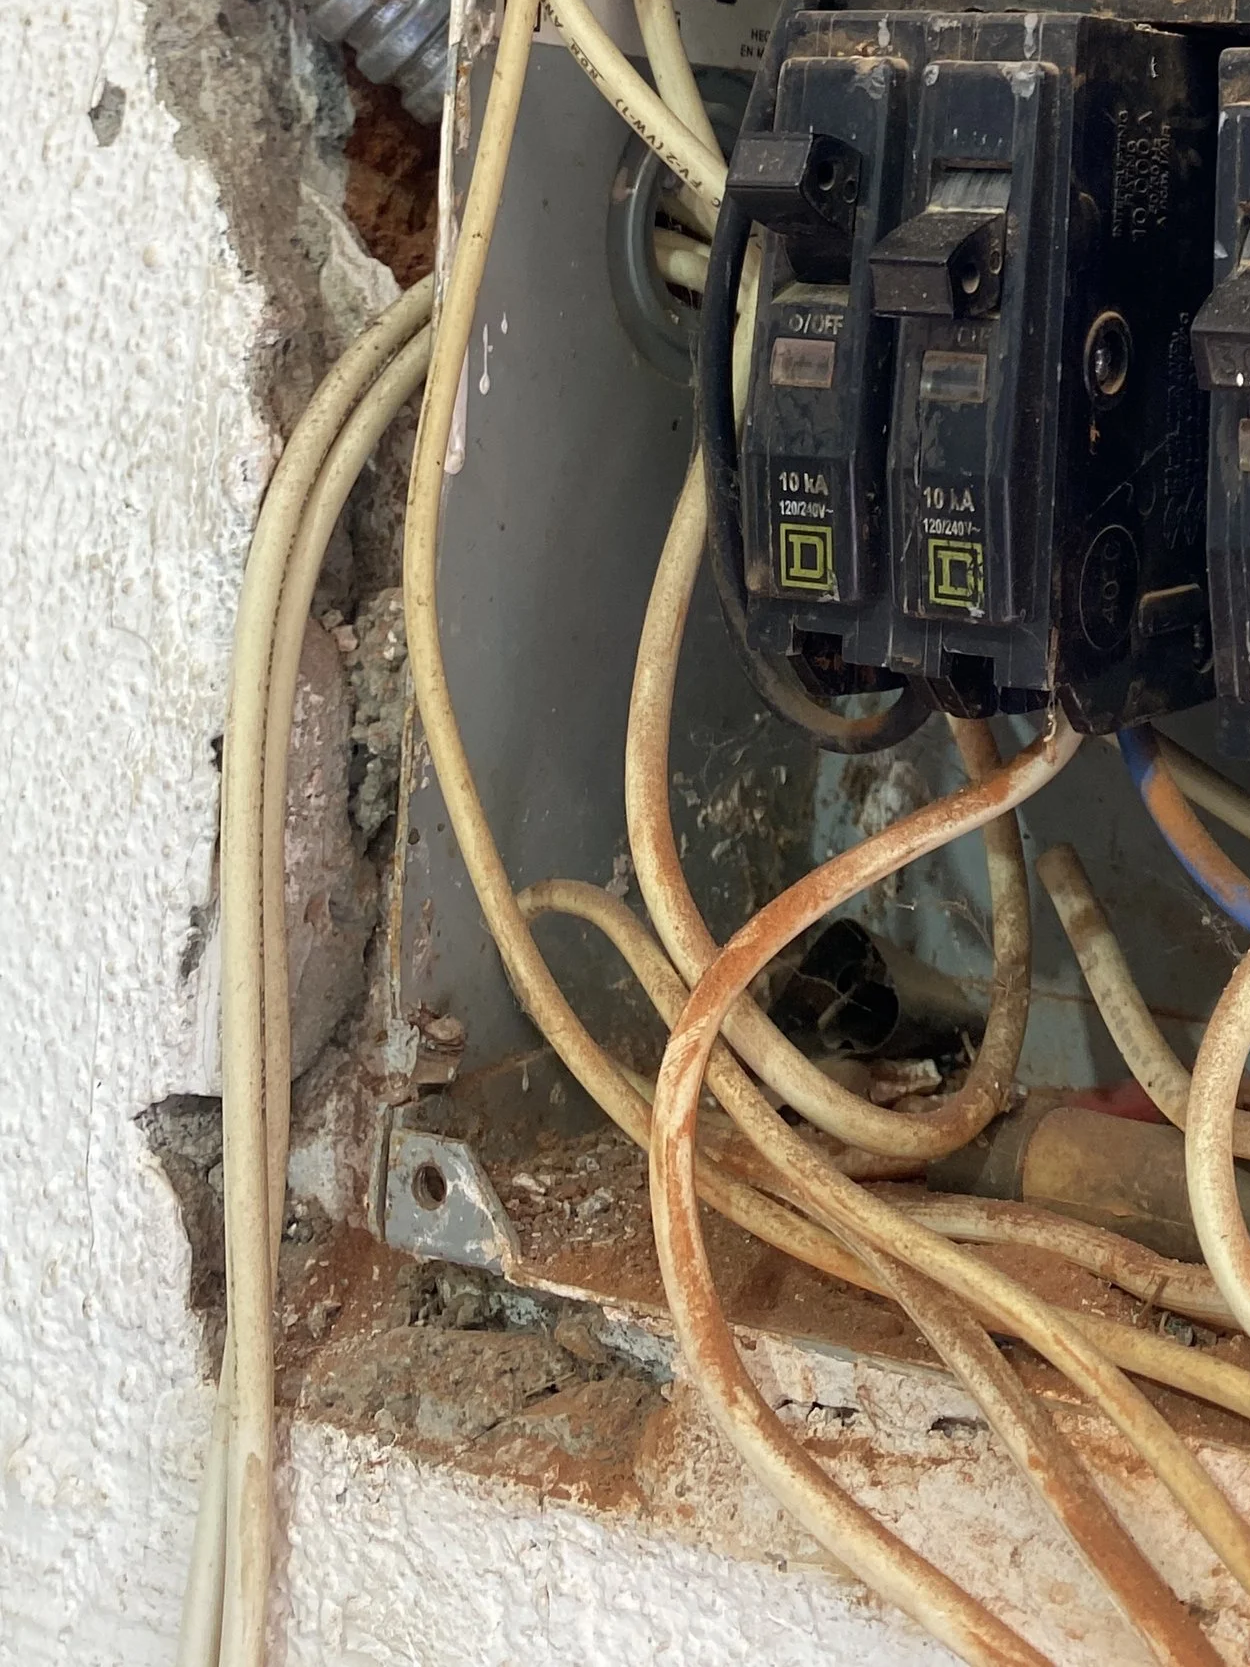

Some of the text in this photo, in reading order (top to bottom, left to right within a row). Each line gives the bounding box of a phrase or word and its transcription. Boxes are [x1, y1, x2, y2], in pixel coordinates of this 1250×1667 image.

[751, 27, 771, 43] HEC
[570, 40, 600, 81] NOM
[779, 470, 829, 496] 10 kA
[923, 486, 945, 510] 10
